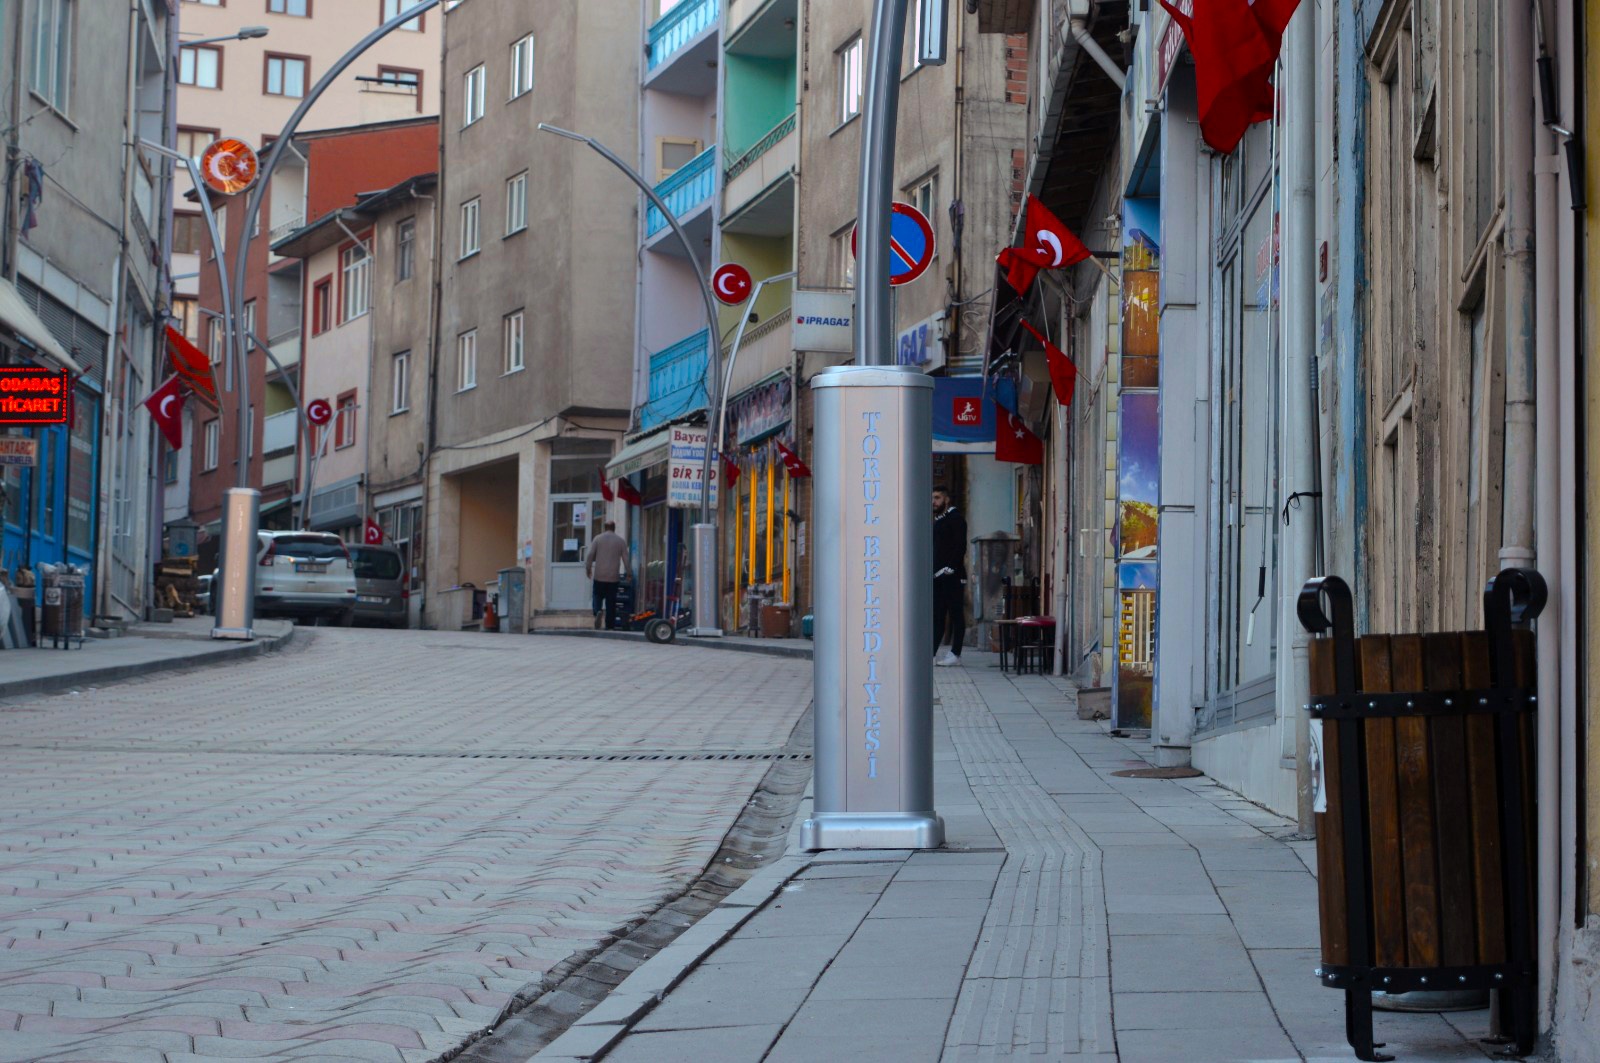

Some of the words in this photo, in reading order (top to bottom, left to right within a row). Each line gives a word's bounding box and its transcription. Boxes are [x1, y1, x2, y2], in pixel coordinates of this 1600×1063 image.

[897, 323, 928, 366] GAZ
[0, 377, 61, 394] ODABAŞ
[0, 395, 61, 412] TİCARET
[673, 430, 717, 444] Bayra
[672, 465, 692, 480] BİR
[697, 469, 717, 480] TD
[862, 411, 882, 525] TORUL
